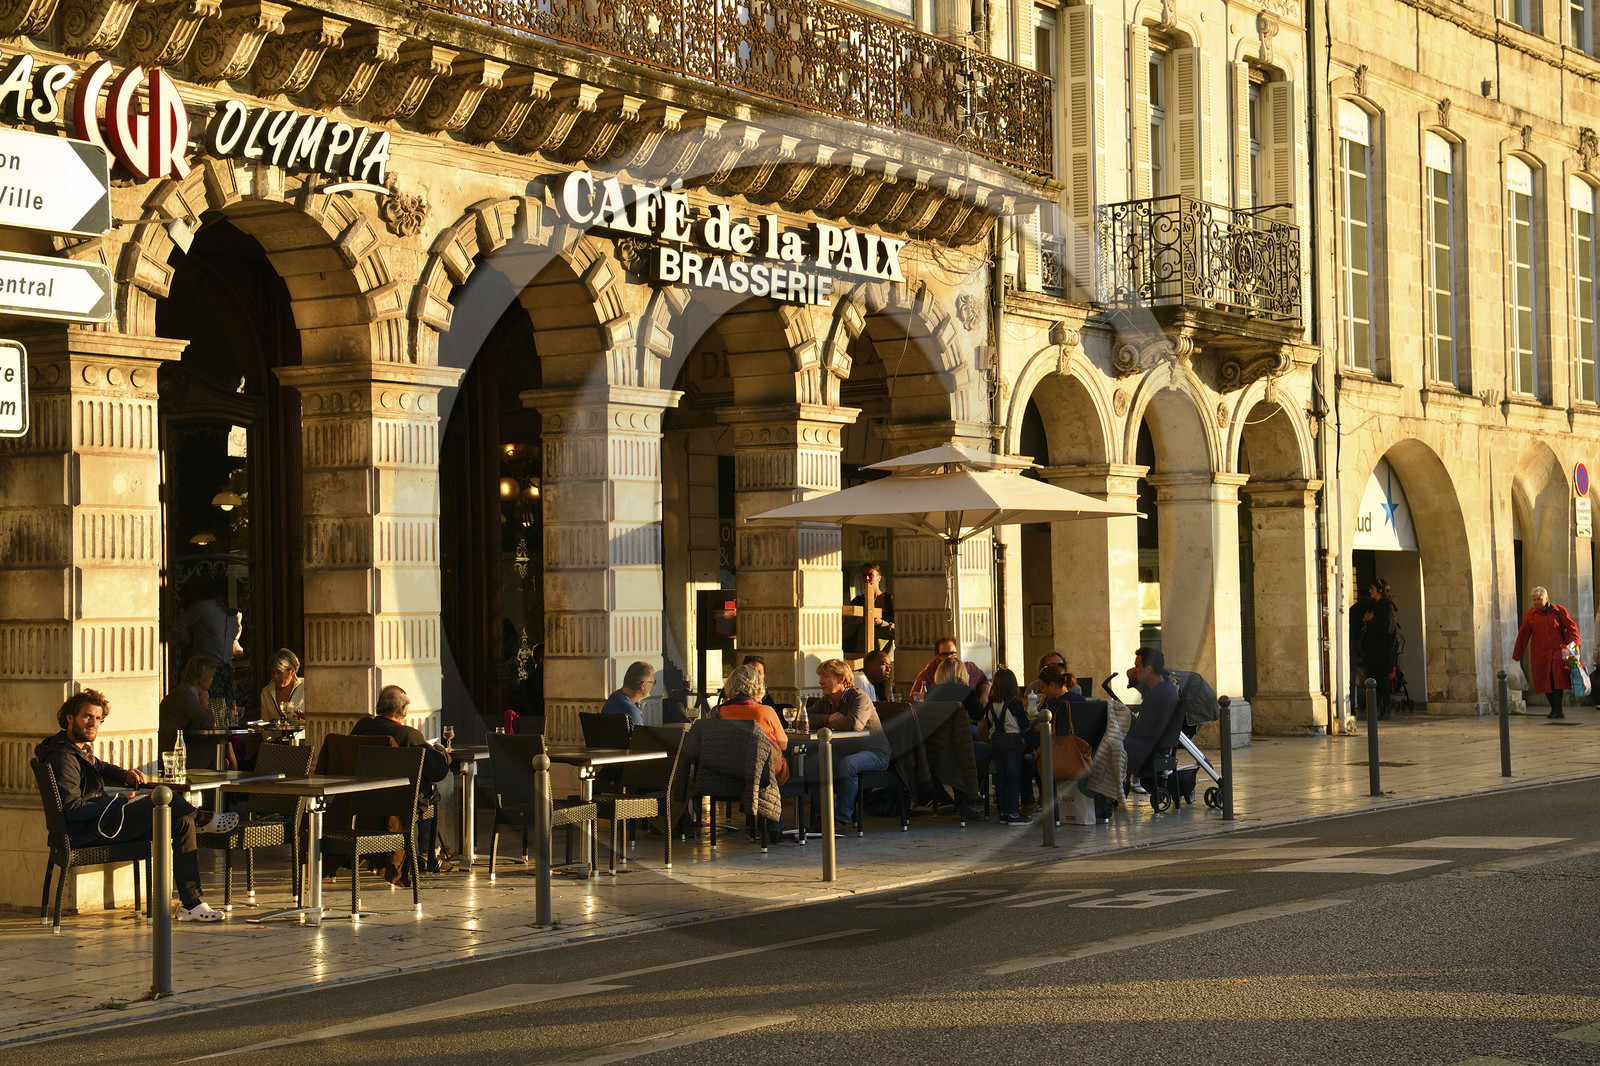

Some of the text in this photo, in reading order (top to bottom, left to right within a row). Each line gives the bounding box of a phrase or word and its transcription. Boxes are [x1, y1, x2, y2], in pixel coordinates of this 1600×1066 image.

[83, 60, 192, 180] CGR
[215, 100, 391, 185] OLYMPIA
[563, 170, 906, 283] CAFÉ de la PAIX
[659, 247, 833, 307] BRASSERIE
[1355, 511, 1372, 532] ud
